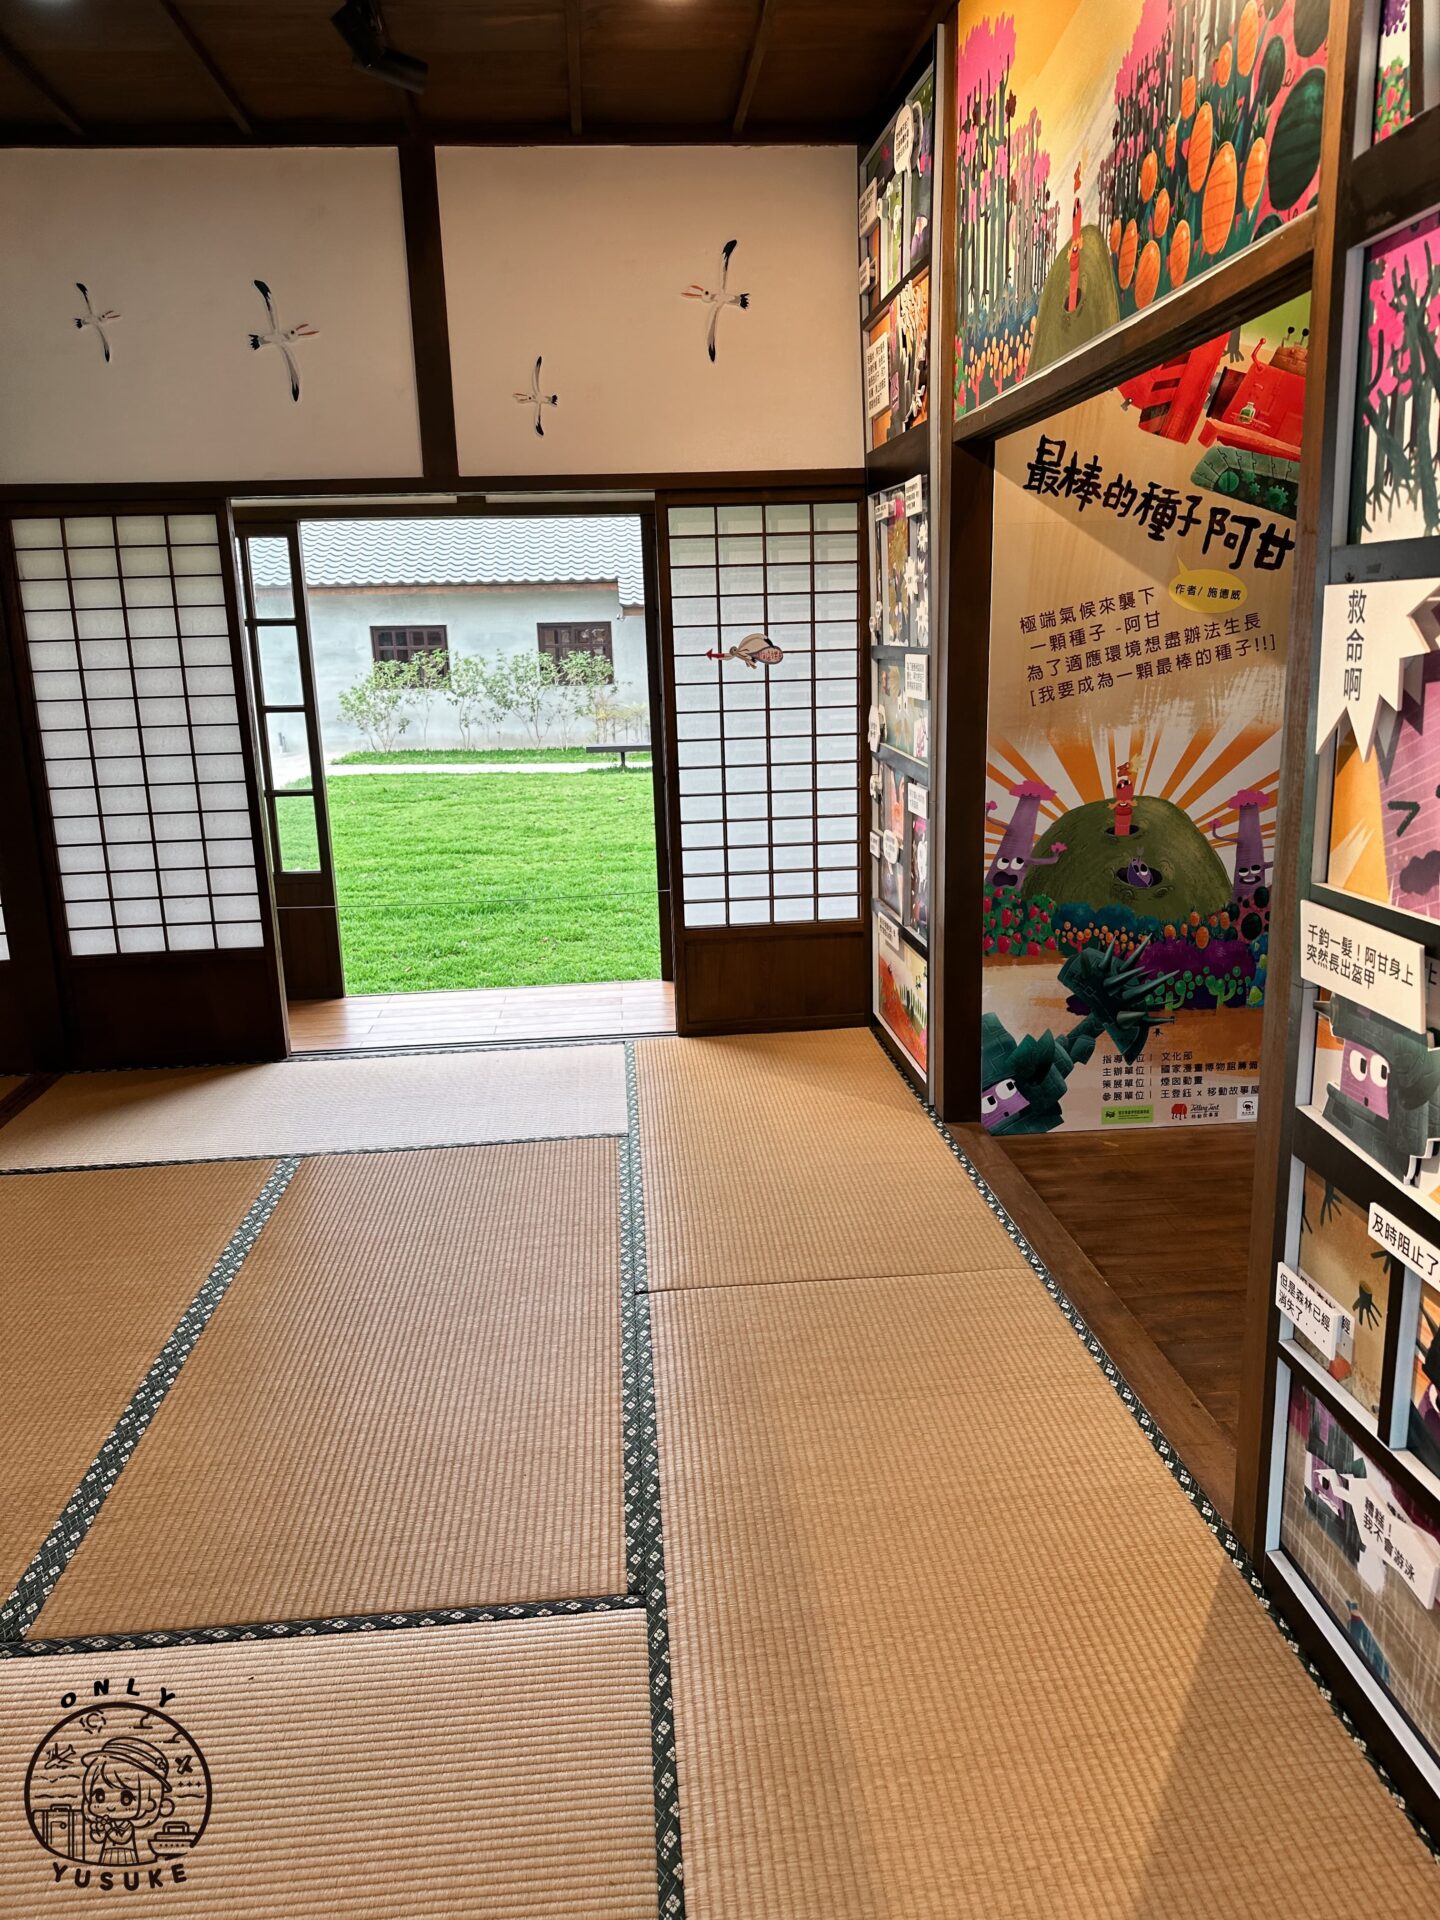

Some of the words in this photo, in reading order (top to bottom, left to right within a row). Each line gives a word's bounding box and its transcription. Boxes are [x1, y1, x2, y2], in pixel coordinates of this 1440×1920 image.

[1022, 434, 1296, 571] 最棒的種子阿甘
[1020, 586, 1155, 635] 極端氣候來襲下
[1175, 584, 1204, 597] 作者/
[1026, 612, 1262, 683] 為了適應環境想盡辦法生長
[1030, 623, 1106, 653] 一顆種子
[1343, 588, 1367, 702] 救命啊
[1306, 944, 1376, 990] 突然長出盔甲
[1102, 1053, 1145, 1064] 指導位
[1161, 1051, 1193, 1062] 文化部
[1102, 1066, 1145, 1077] 主辦單位
[1102, 1078, 1145, 1089] 策展單位
[1279, 1272, 1331, 1333] 但是森林已經
[1363, 1512, 1415, 1583] 我不會游泳
